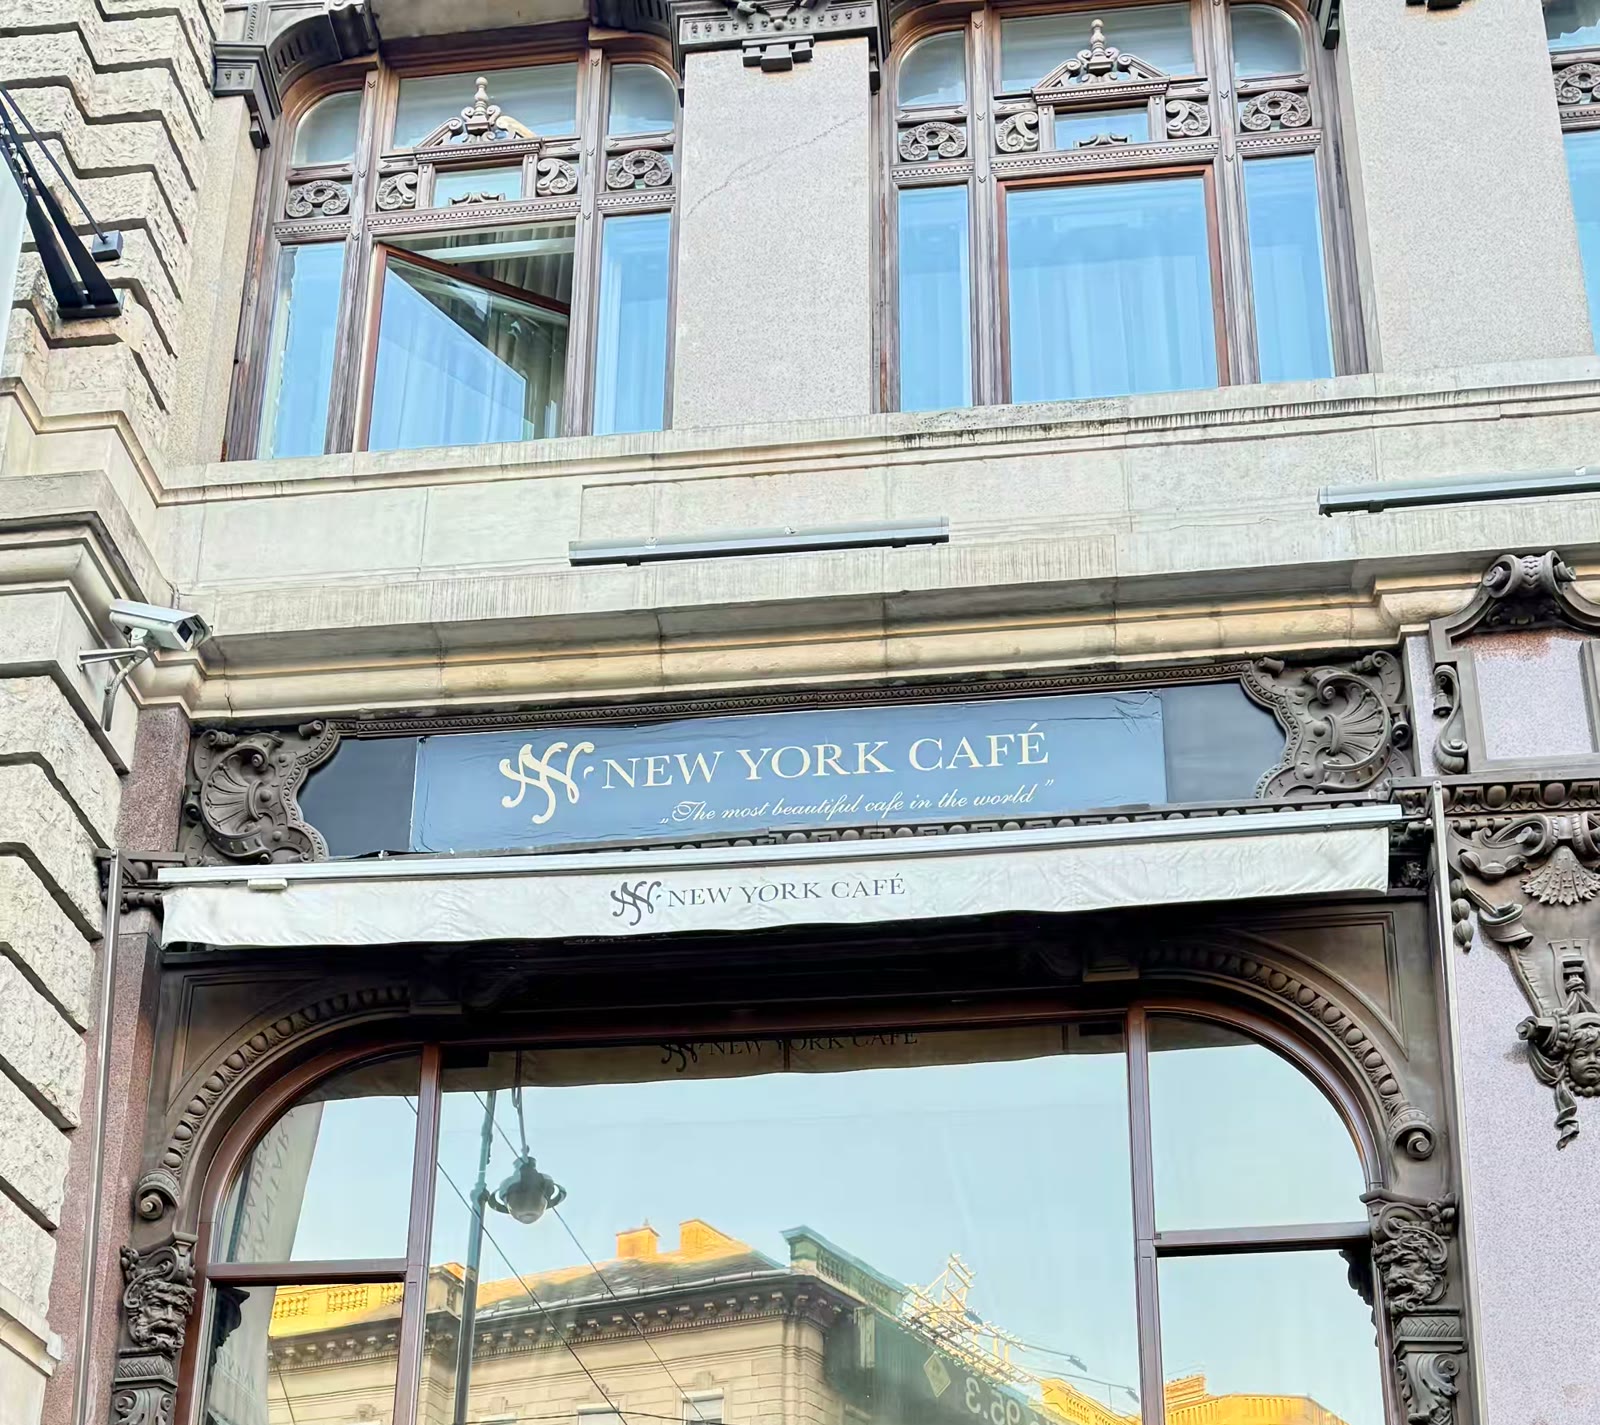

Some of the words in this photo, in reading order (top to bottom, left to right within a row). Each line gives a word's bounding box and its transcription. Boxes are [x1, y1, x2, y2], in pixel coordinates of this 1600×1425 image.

[602, 750, 724, 789] NEW
[736, 740, 895, 782] YORK
[908, 722, 1049, 772] CAFÉ
[721, 802, 770, 819] most
[772, 793, 865, 821] beautiful
[864, 790, 905, 819] cafe
[909, 794, 933, 810] in
[937, 788, 968, 809] the
[667, 886, 732, 907] NEW
[738, 881, 822, 903] YORK
[830, 873, 906, 898] CAFÉ
